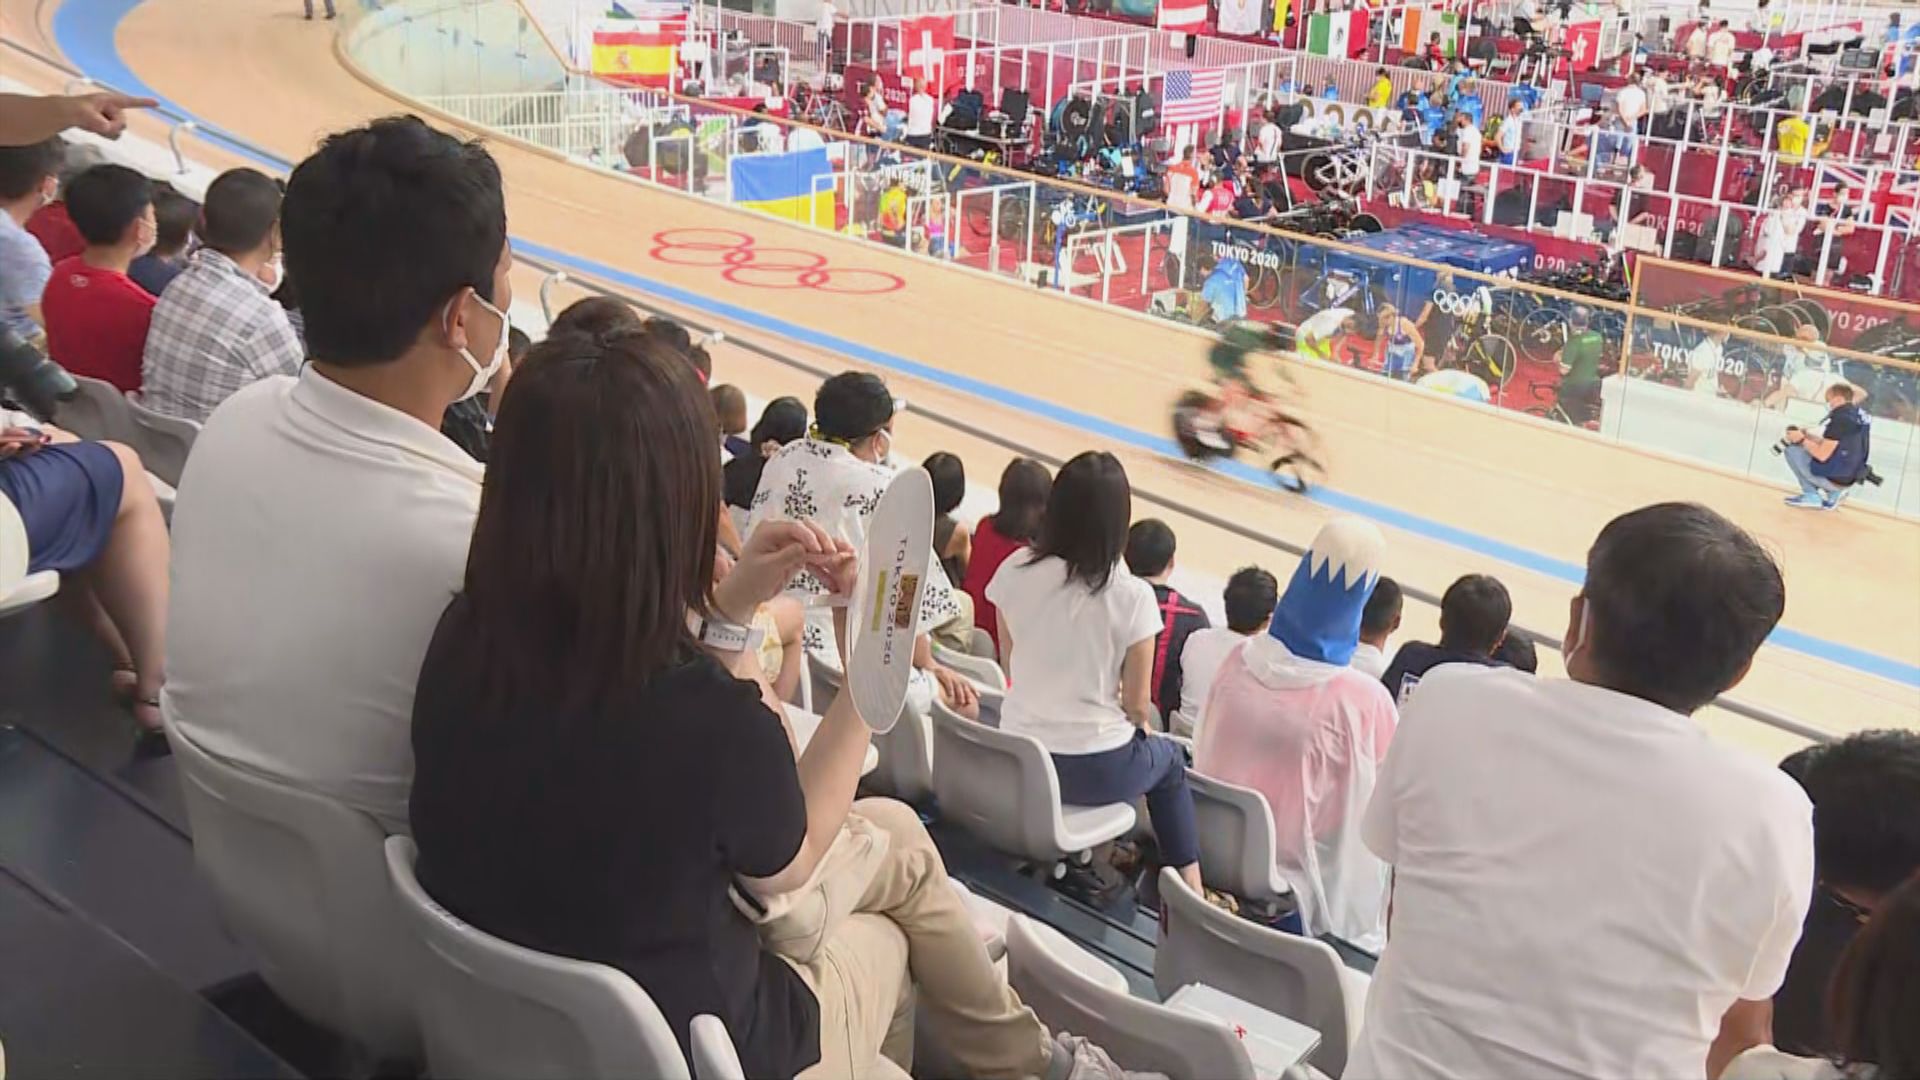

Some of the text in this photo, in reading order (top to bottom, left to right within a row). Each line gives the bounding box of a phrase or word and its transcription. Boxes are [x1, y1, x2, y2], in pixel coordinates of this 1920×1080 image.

[1211, 240, 1280, 270] TOKYO 2020
[883, 536, 908, 666] TOKYO 2020
